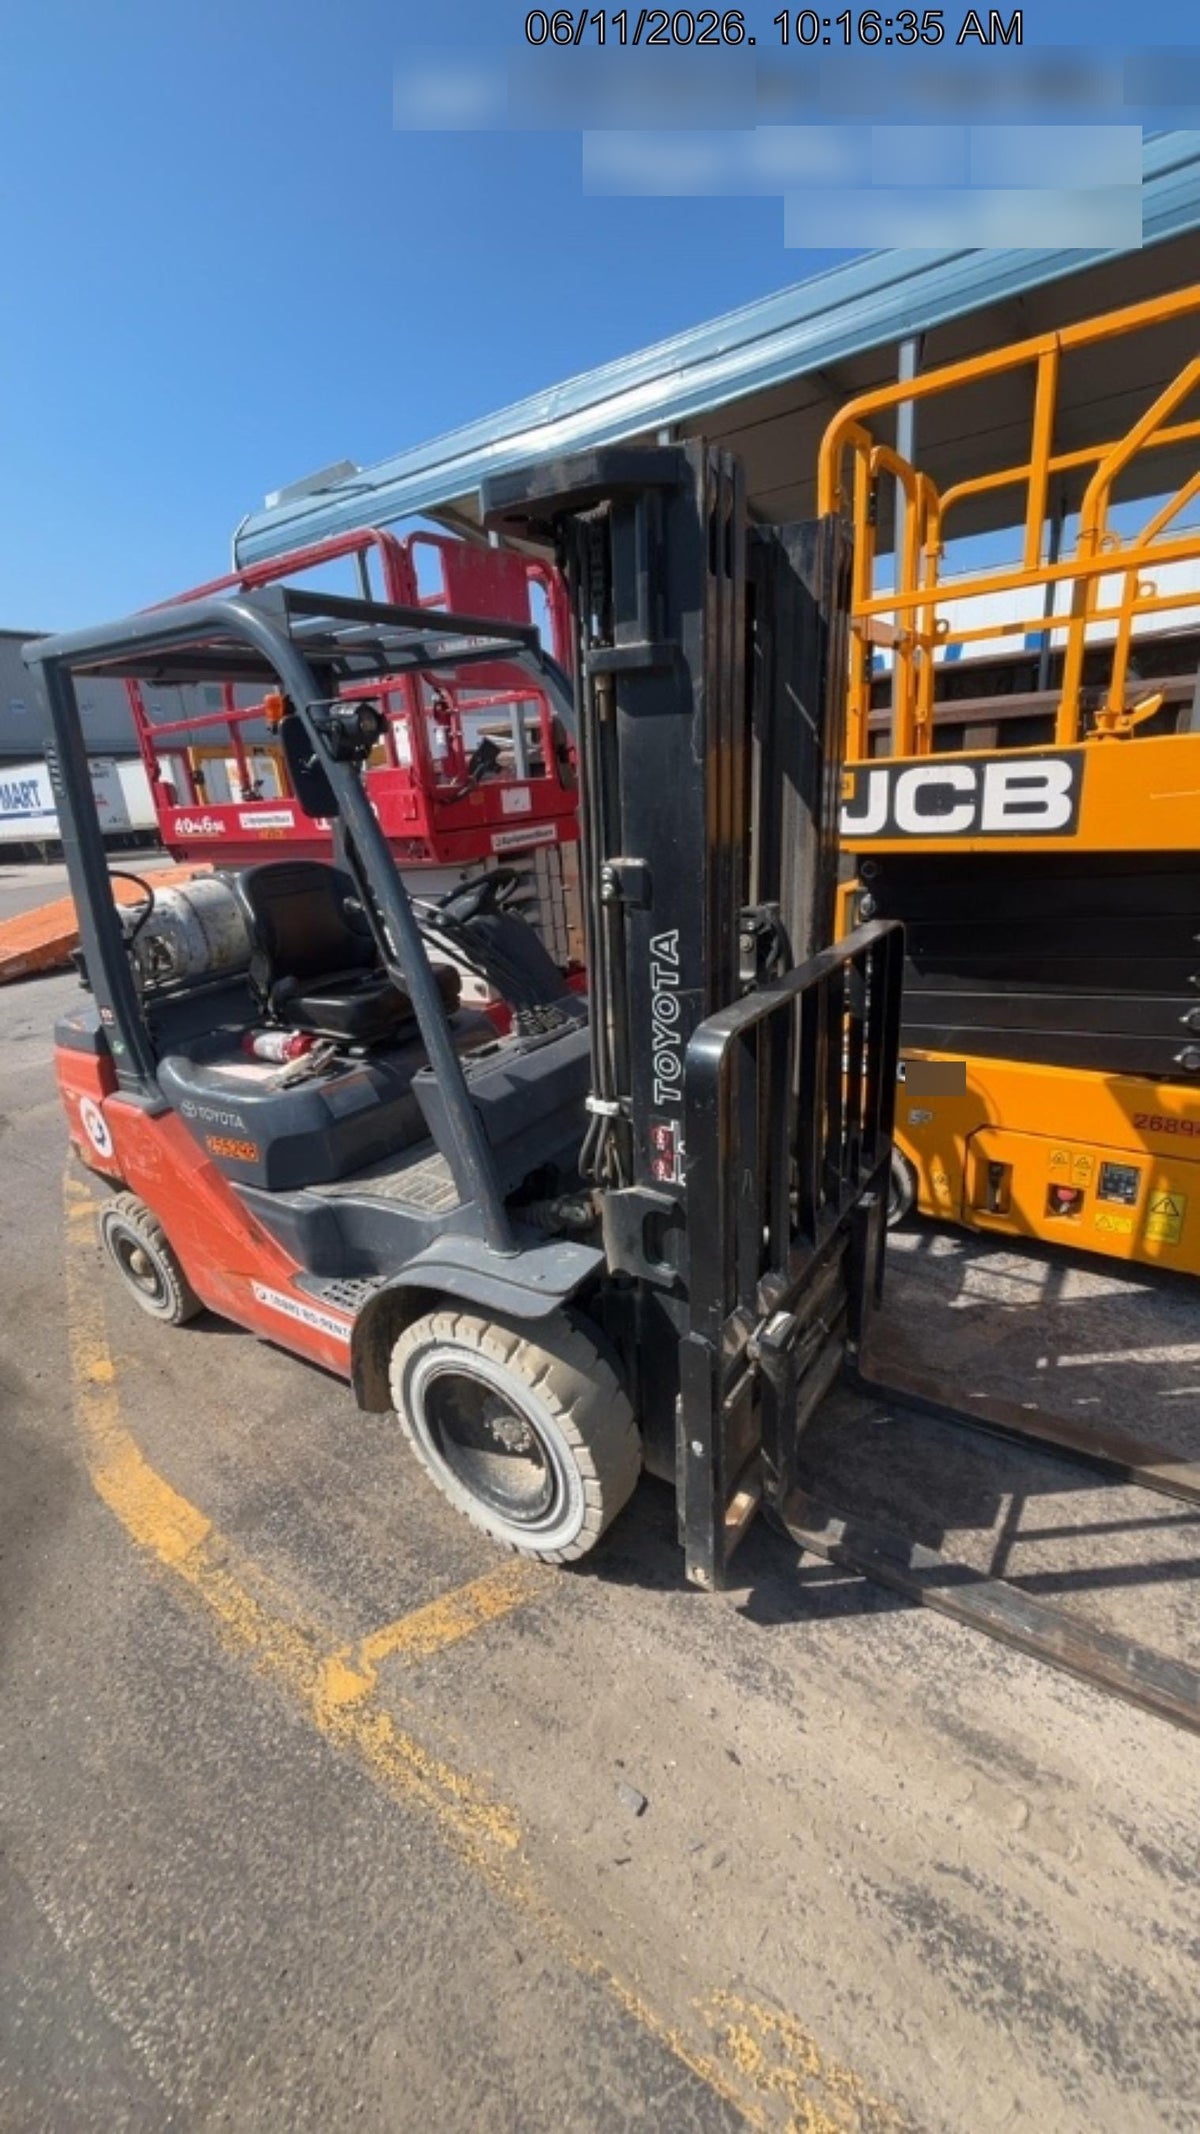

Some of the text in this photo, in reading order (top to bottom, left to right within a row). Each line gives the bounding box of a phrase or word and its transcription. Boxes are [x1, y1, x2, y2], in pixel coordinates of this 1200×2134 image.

[839, 760, 1073, 835] JCB
[650, 929, 681, 1105] TOYOTA
[198, 1106, 248, 1132] TOYOTA
[1133, 1111, 1200, 1138] 2689
